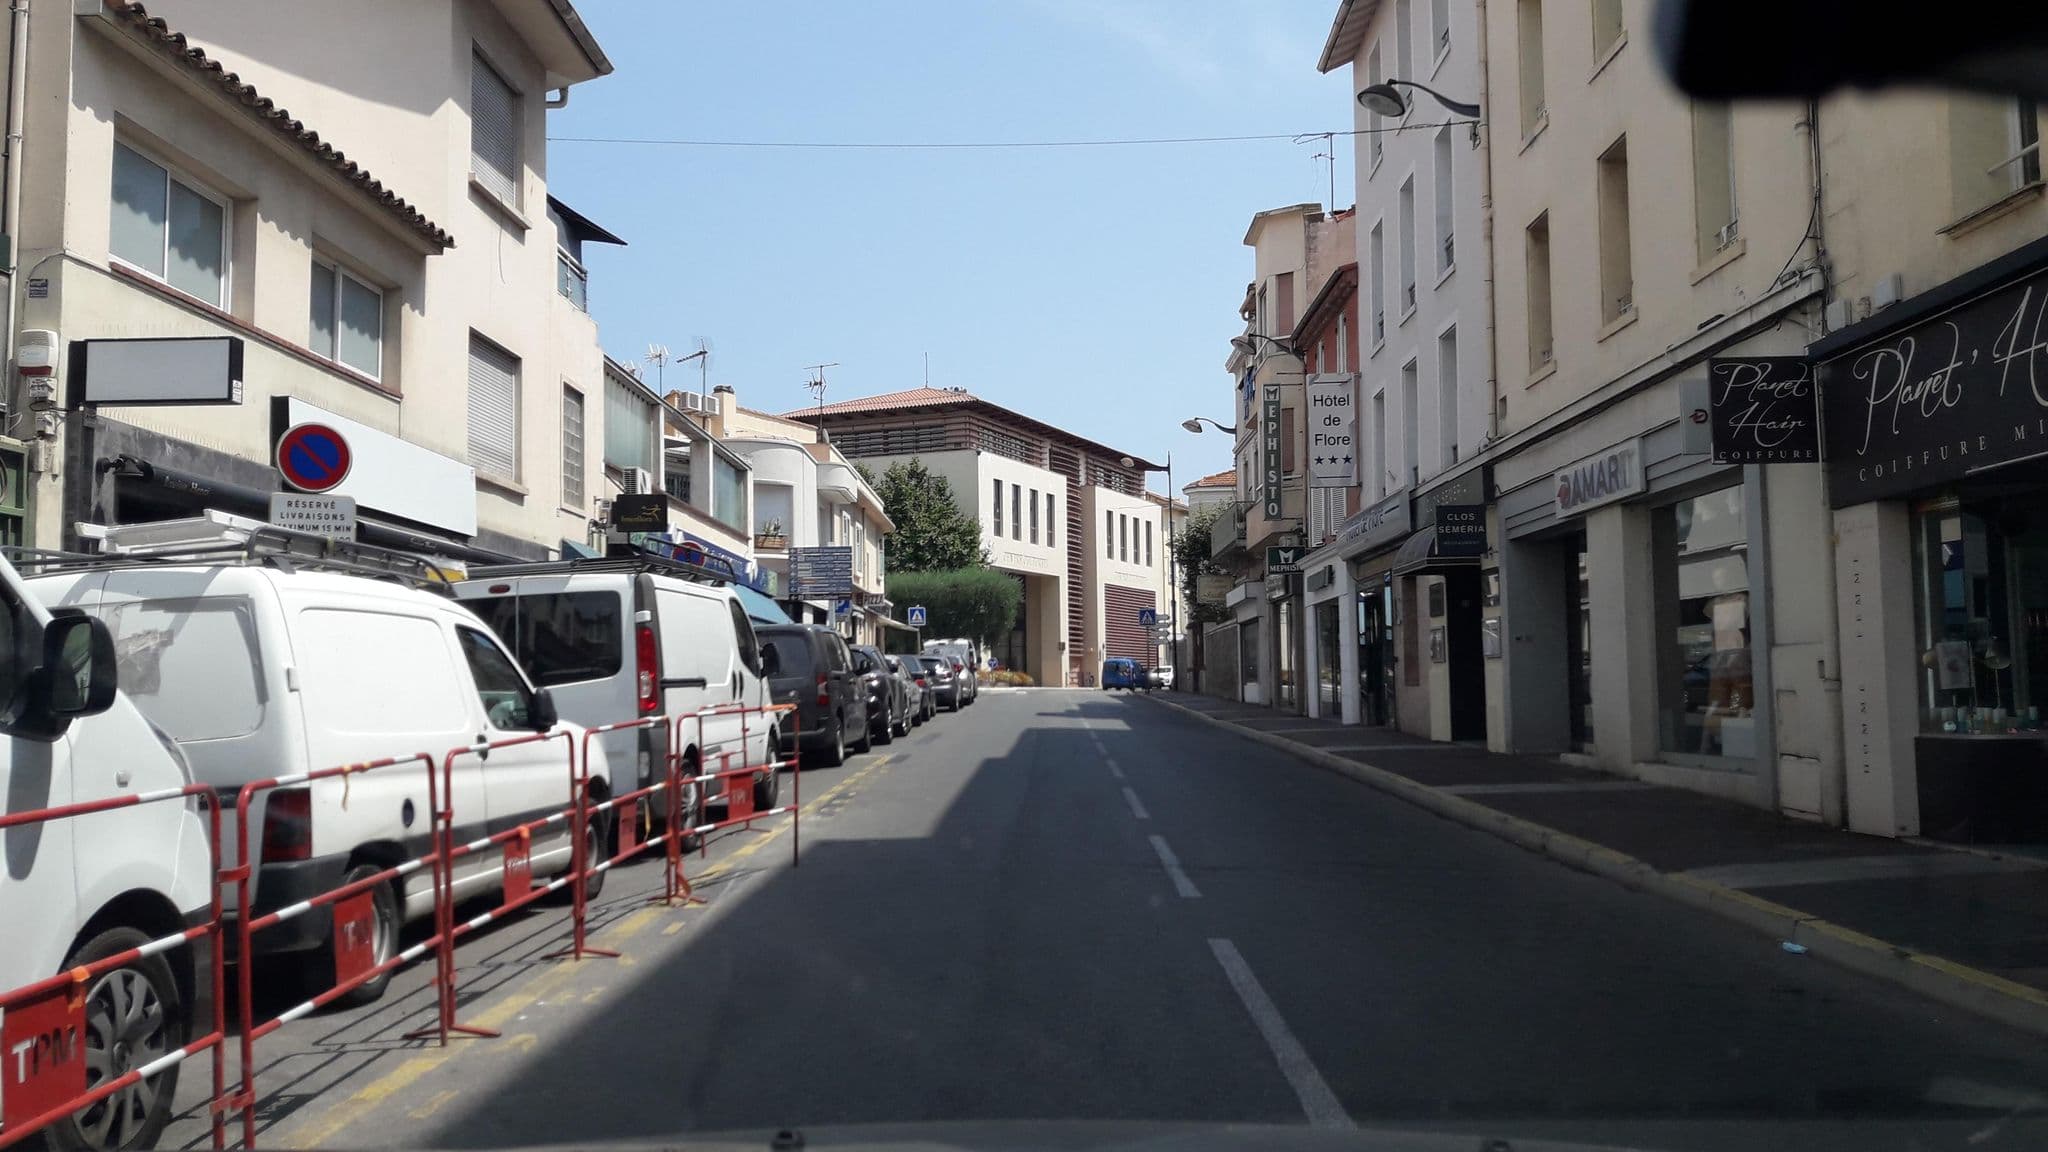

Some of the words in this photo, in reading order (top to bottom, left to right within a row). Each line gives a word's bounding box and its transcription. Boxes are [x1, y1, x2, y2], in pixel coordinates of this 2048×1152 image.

[1713, 362, 1810, 407] Planet
[1313, 394, 1350, 408] Hôtel
[1322, 414, 1341, 427] de
[1728, 400, 1806, 448] Hair
[1314, 433, 1351, 446] Flore
[1264, 386, 1280, 517] MEPHISTO
[1719, 449, 1813, 460] COIFFURE
[1859, 435, 1987, 483] COIFFURE
[286, 500, 336, 510] RÉSERVÉ
[280, 512, 345, 521] LIVRAISONS
[1446, 512, 1476, 521] CLOS
[322, 524, 332, 533] 15
[334, 525, 351, 533] MIN
[865, 595, 885, 605] PIZZA
